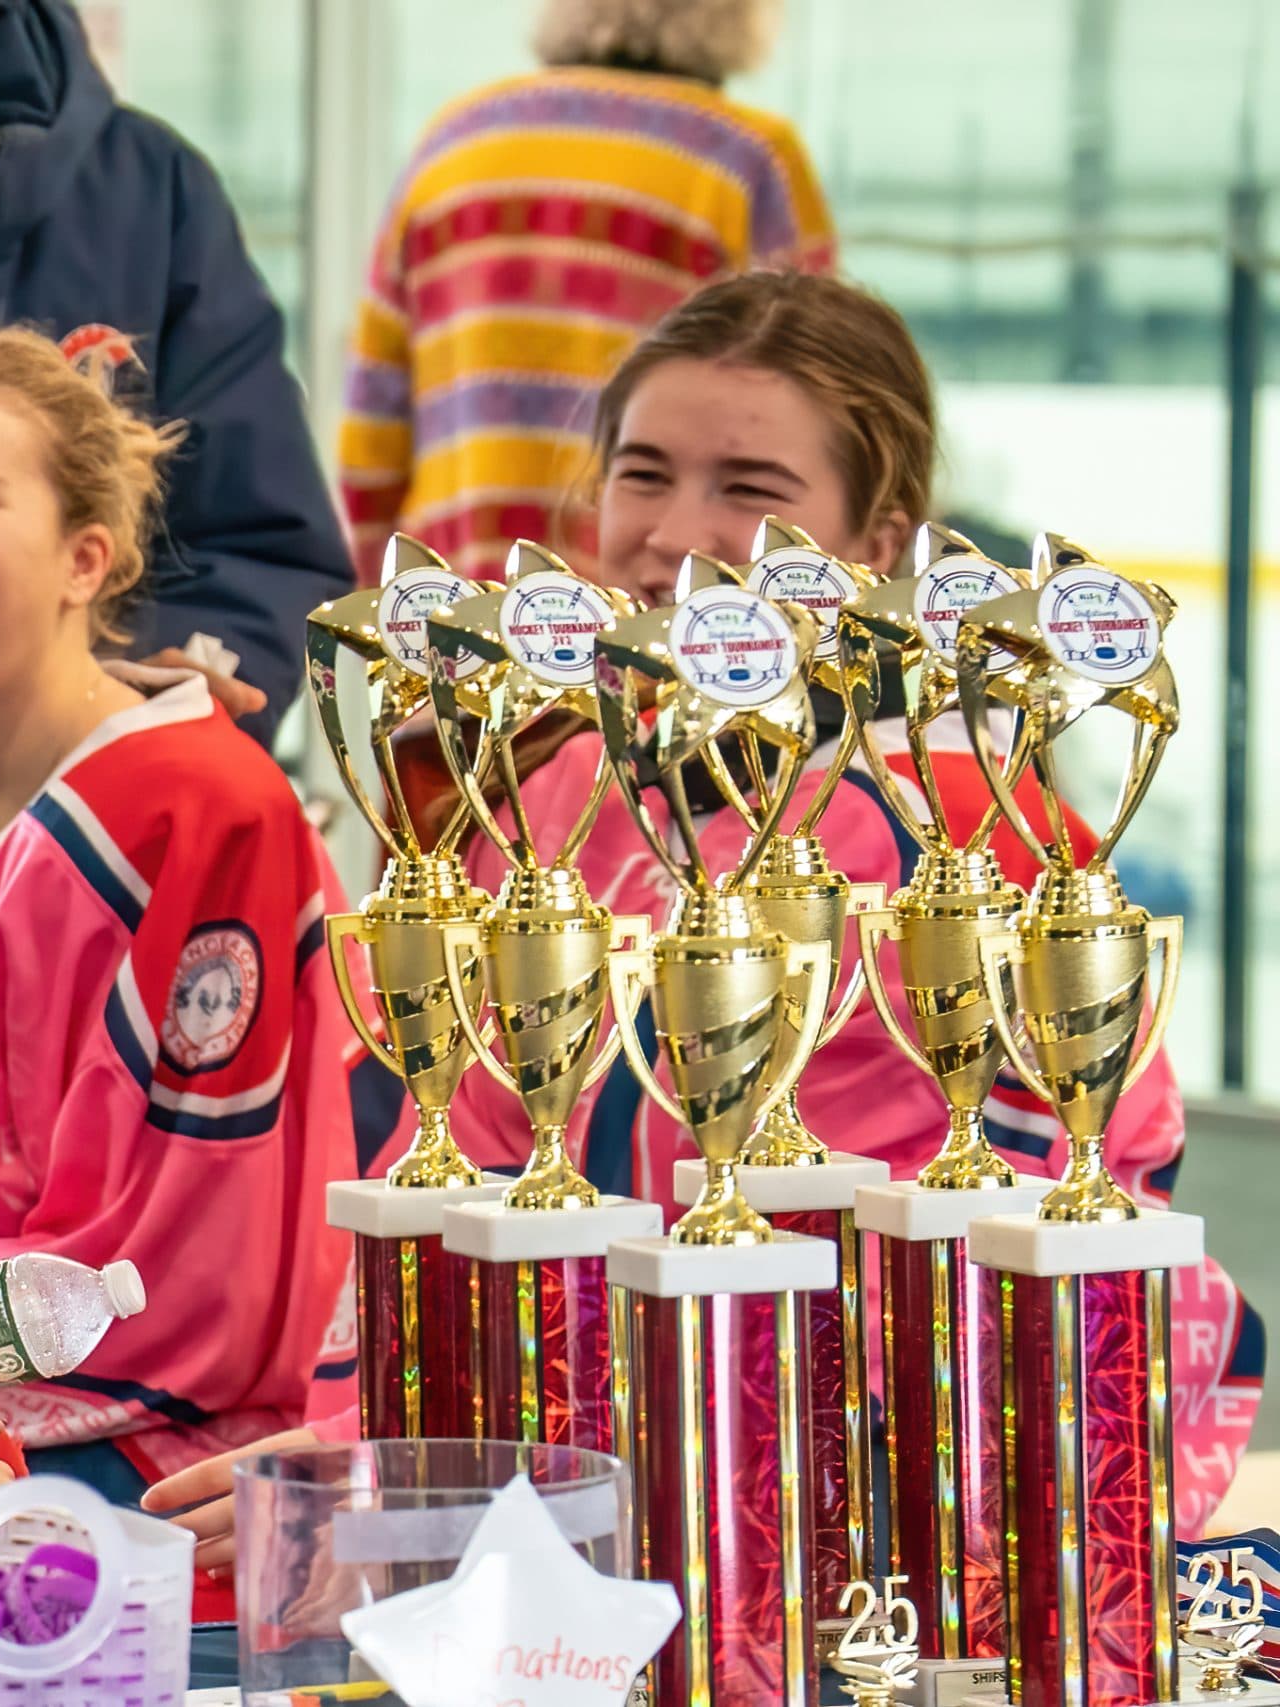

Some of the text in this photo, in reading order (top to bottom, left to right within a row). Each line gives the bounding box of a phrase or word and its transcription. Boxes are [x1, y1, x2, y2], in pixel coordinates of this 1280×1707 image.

[508, 624, 544, 636] HOCKEY
[1048, 618, 1149, 633] HOCKEY TOURNAMENT
[680, 638, 787, 656] HOCKEY TOURNAMENT
[1186, 1546, 1265, 1630] 25
[838, 1575, 919, 1660] 25
